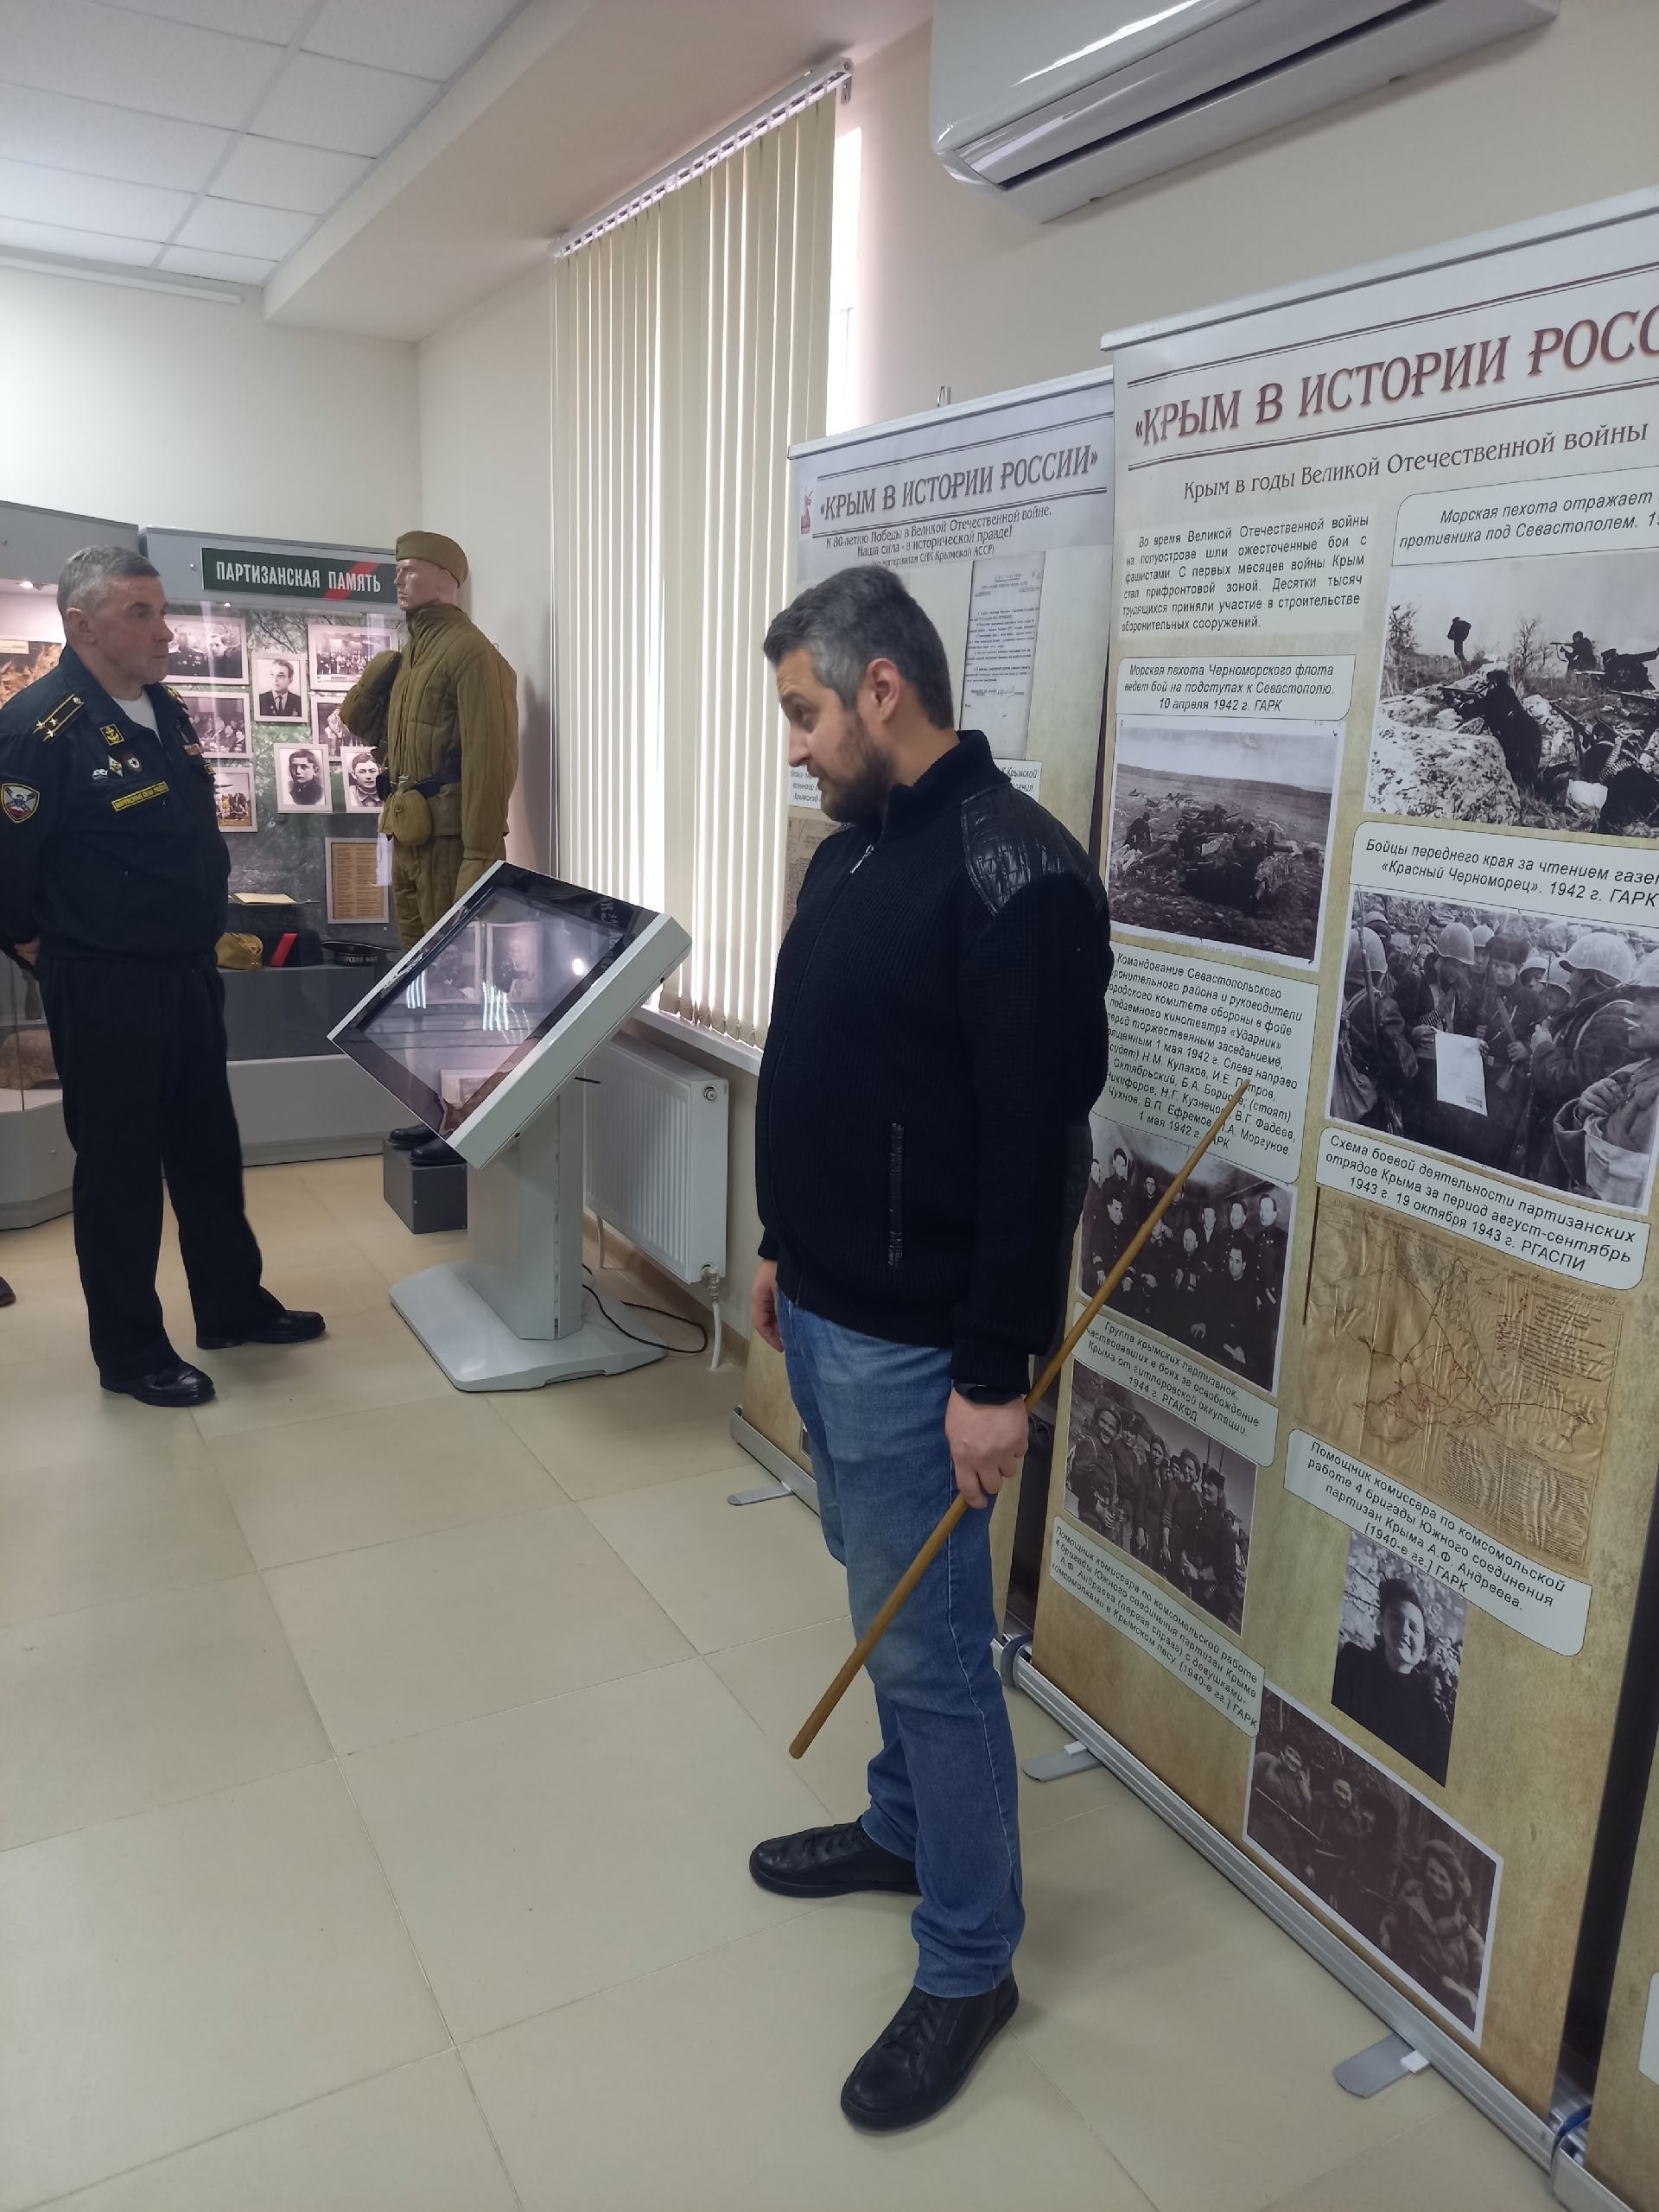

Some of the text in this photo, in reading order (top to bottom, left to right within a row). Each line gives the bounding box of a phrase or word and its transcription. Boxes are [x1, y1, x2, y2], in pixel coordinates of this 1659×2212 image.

[1135, 389, 1242, 445] «КРЫМ
[1256, 383, 1283, 424] В
[1299, 335, 1511, 418] ИСТОРИИ
[821, 445, 1097, 519] «КРЫМ В ИСТОРИИ РОССИИ»
[1184, 423, 1649, 503] Крым в годы Великой Отечественной войны
[826, 537, 831, 549] К
[870, 528, 902, 543] Победы
[904, 528, 909, 538] в
[911, 520, 947, 537] Великой
[949, 509, 1020, 531] Отечественной
[1021, 505, 1051, 520] войне.
[1440, 492, 1652, 525] Морская пехота отражает
[857, 545, 879, 556] Наша
[880, 543, 899, 555] сила
[906, 541, 911, 551] в
[912, 531, 975, 550] исторической
[976, 524, 1012, 544] правде!
[1138, 515, 1369, 548] Во время Великой Отечественной войны
[1140, 550, 1196, 565] полуострове
[1205, 548, 1228, 558] шли
[1237, 539, 1317, 556] ожесточенные
[1327, 535, 1349, 548] бои
[1360, 535, 1367, 545] с
[1399, 516, 1637, 550] противника под Севастополем.
[216, 561, 381, 593] ПАРТИЗАНСКАЯ ПАМЯТЬ
[1123, 575, 1362, 599] стал прифронтовой зоной. Десятки тысяч
[1125, 553, 1364, 584] фашистами. С первых месяцев войны Крым
[1122, 594, 1360, 618] трудящихся приняли участие в строительстве
[1122, 614, 1260, 633] оборонительных сооружений.
[1124, 680, 1333, 696] ведет бой на подступах к Севастополю.
[1129, 663, 1334, 678] Морская пехота Черноморского флота
[1160, 697, 1282, 712] 10 апреля 1942 г. ГАРК
[1365, 838, 1408, 856] Бойцы
[1411, 846, 1479, 863] переднего
[1482, 855, 1514, 868] края
[1517, 859, 1534, 871] за
[1539, 861, 1609, 880] чтением
[1382, 860, 1658, 907] «Красный Черноморец». 1942 г. ГАРК
[1116, 952, 1184, 976] Командование
[1187, 967, 1281, 999] Севастопольского
[1154, 994, 1208, 1014] комитета
[1211, 1006, 1253, 1026] обороны
[1255, 1019, 1262, 1027] в
[1264, 1019, 1292, 1036] фойе
[1181, 984, 1218, 1000] района
[1221, 993, 1228, 1002] и
[1229, 995, 1302, 1021] руководители
[1109, 998, 1281, 1050] подземного кинотеатра «Ударник»
[1131, 1020, 1215, 1047] торжественным
[1325, 1153, 1377, 1177] отрядов
[1381, 1168, 1421, 1192] Крыма
[1425, 1185, 1439, 1198] за
[1442, 1192, 1488, 1217] период
[1491, 1211, 1630, 1262] август-сентябрь
[1331, 1135, 1636, 1243] Схема боевой деятельности партизанских
[1350, 1176, 1377, 1194] 1943
[1380, 1189, 1389, 1199] г.
[1396, 1192, 1410, 1206] 19
[1413, 1201, 1467, 1229] октября
[1471, 1220, 1502, 1242] 1943
[1504, 1236, 1514, 1248] г.
[1521, 1239, 1586, 1271] РГАСПИ
[1104, 1321, 1237, 1401] Группа крымских партизанок,
[1307, 1458, 1554, 1606] работе 4 бригады Южного соединения
[1310, 1440, 1565, 1592] Помощник комиссара по комсомольской
[1325, 1484, 1522, 1610] партизан Крыма А.Ф. Андреева.
[1434, 1564, 1468, 1593] ГАРК
[1056, 1525, 1257, 1683] Помощник комиссара по комсомольской работе
